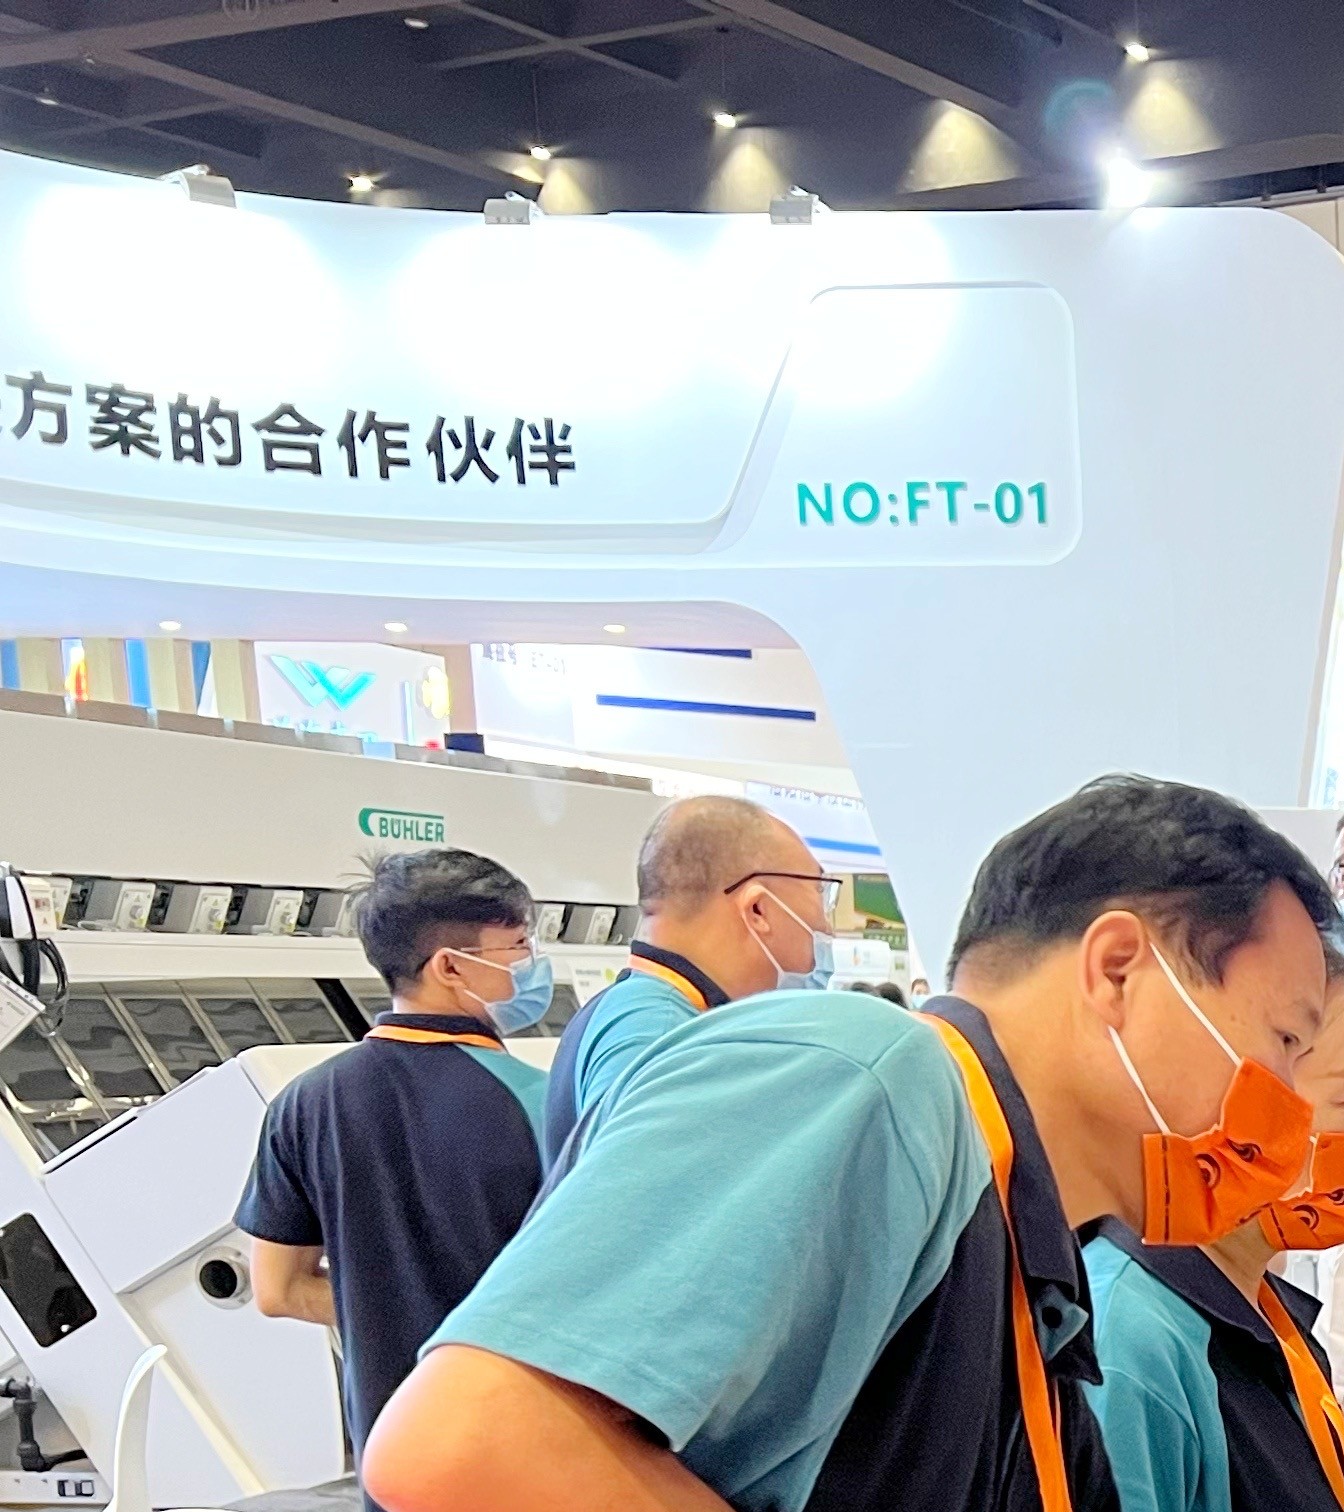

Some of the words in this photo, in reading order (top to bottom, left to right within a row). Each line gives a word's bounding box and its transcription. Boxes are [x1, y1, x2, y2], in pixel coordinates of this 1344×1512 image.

[0, 370, 576, 487] 方案的合作伙伴
[796, 481, 1048, 526] NO:FT-01
[378, 815, 445, 843] BÜHLER
